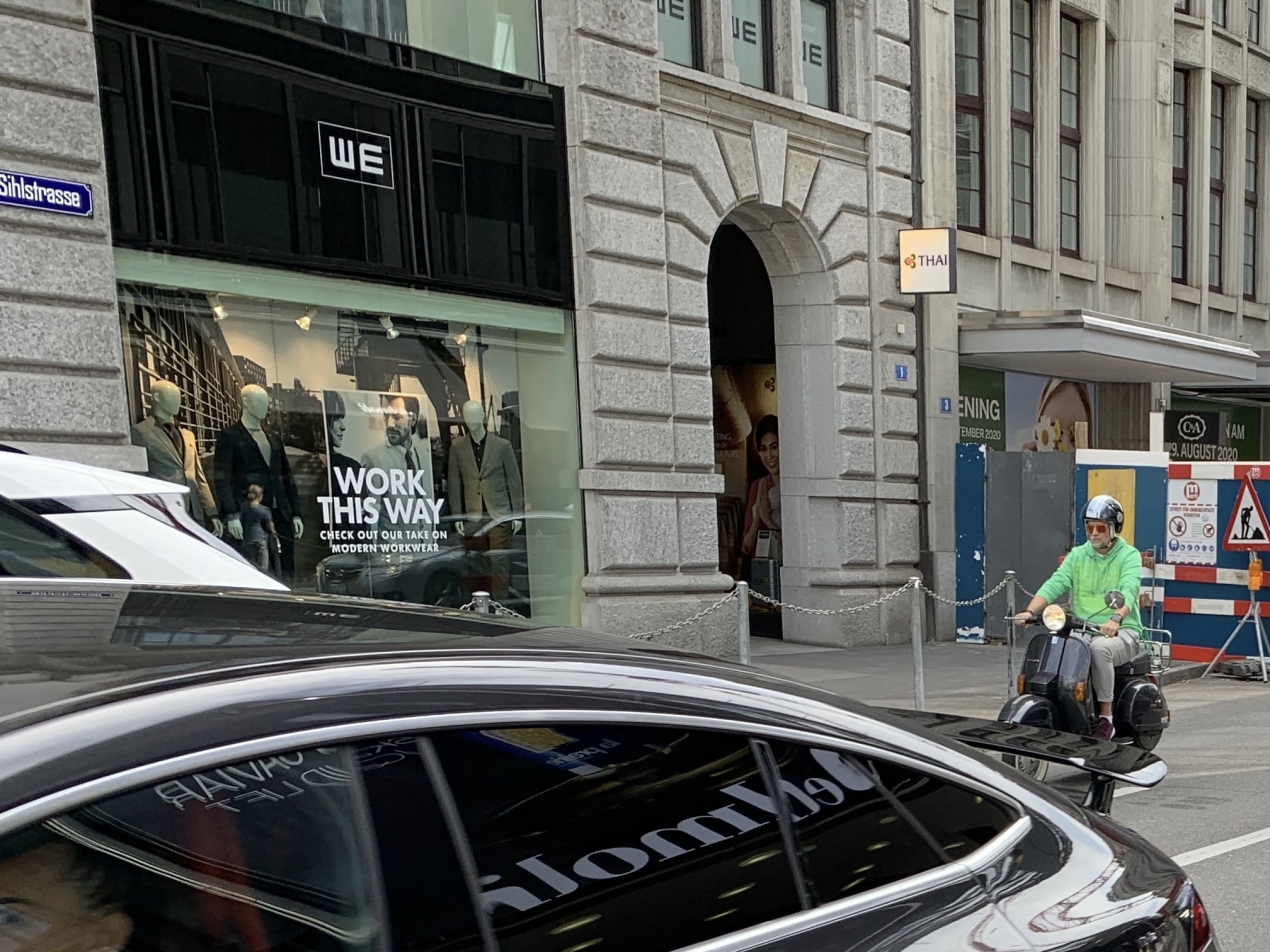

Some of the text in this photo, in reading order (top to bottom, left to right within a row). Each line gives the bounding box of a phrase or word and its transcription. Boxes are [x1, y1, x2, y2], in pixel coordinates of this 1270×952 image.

[328, 135, 384, 176] WE
[0, 174, 80, 207] Sihlstrasse
[918, 254, 948, 266] THAI
[985, 429, 1001, 440] 2020
[1182, 421, 1200, 434] C&A
[1231, 424, 1245, 440] AM
[1181, 443, 1216, 460] AUGUST
[1217, 446, 1238, 461] 2020
[333, 466, 427, 495] WORK
[317, 496, 445, 524] THIS WAY
[320, 530, 448, 540] CHECK OUT OUR TAKE ON
[332, 543, 440, 553] MODERN WORKWEAR
